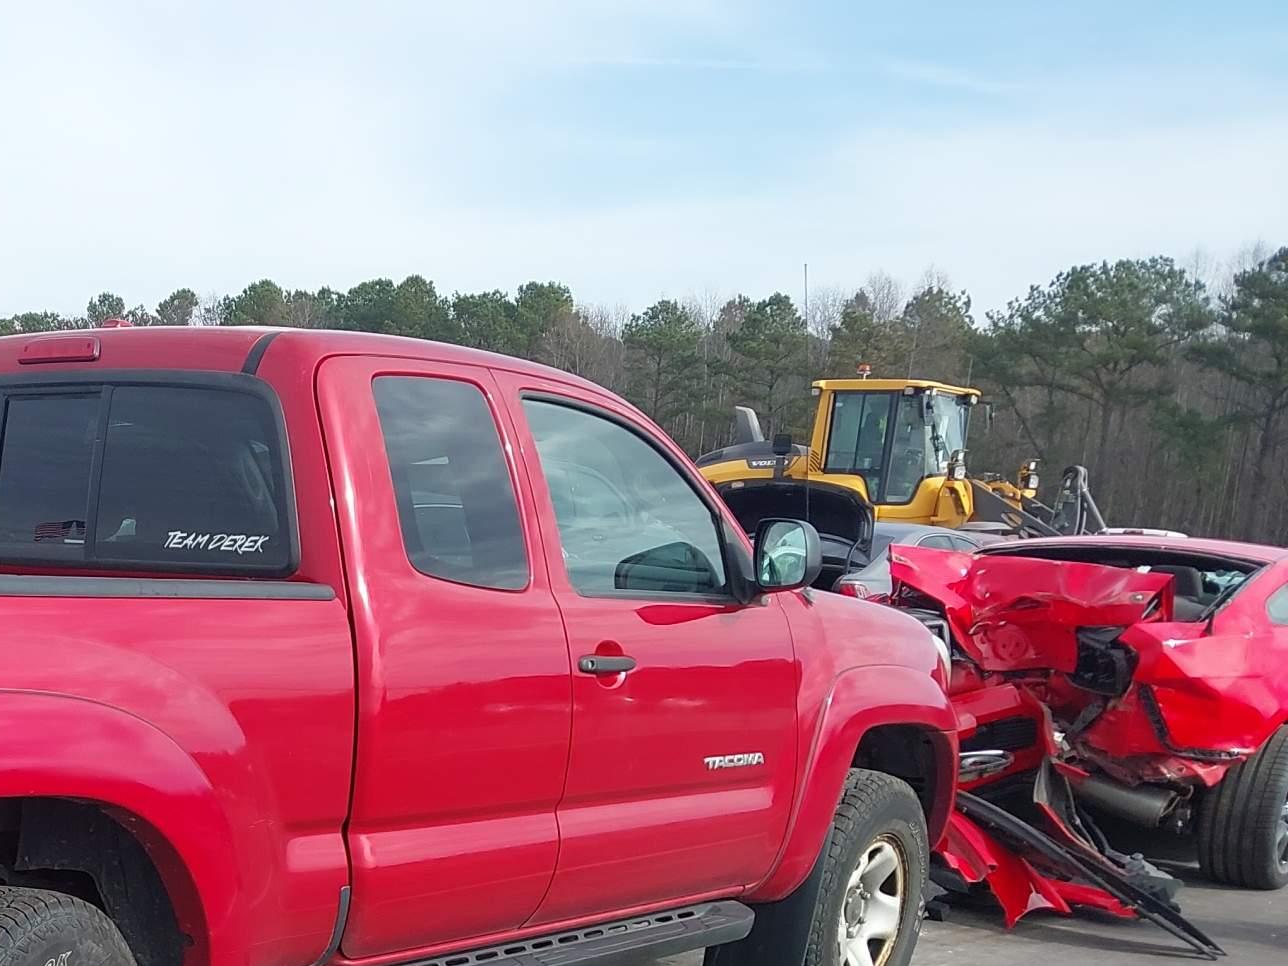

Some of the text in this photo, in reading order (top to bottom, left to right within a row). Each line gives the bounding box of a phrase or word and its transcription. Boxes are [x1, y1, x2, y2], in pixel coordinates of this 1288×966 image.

[751, 459, 789, 467] VOLO
[164, 531, 269, 554] TEAM DEREK
[704, 752, 765, 769] TACOMA
